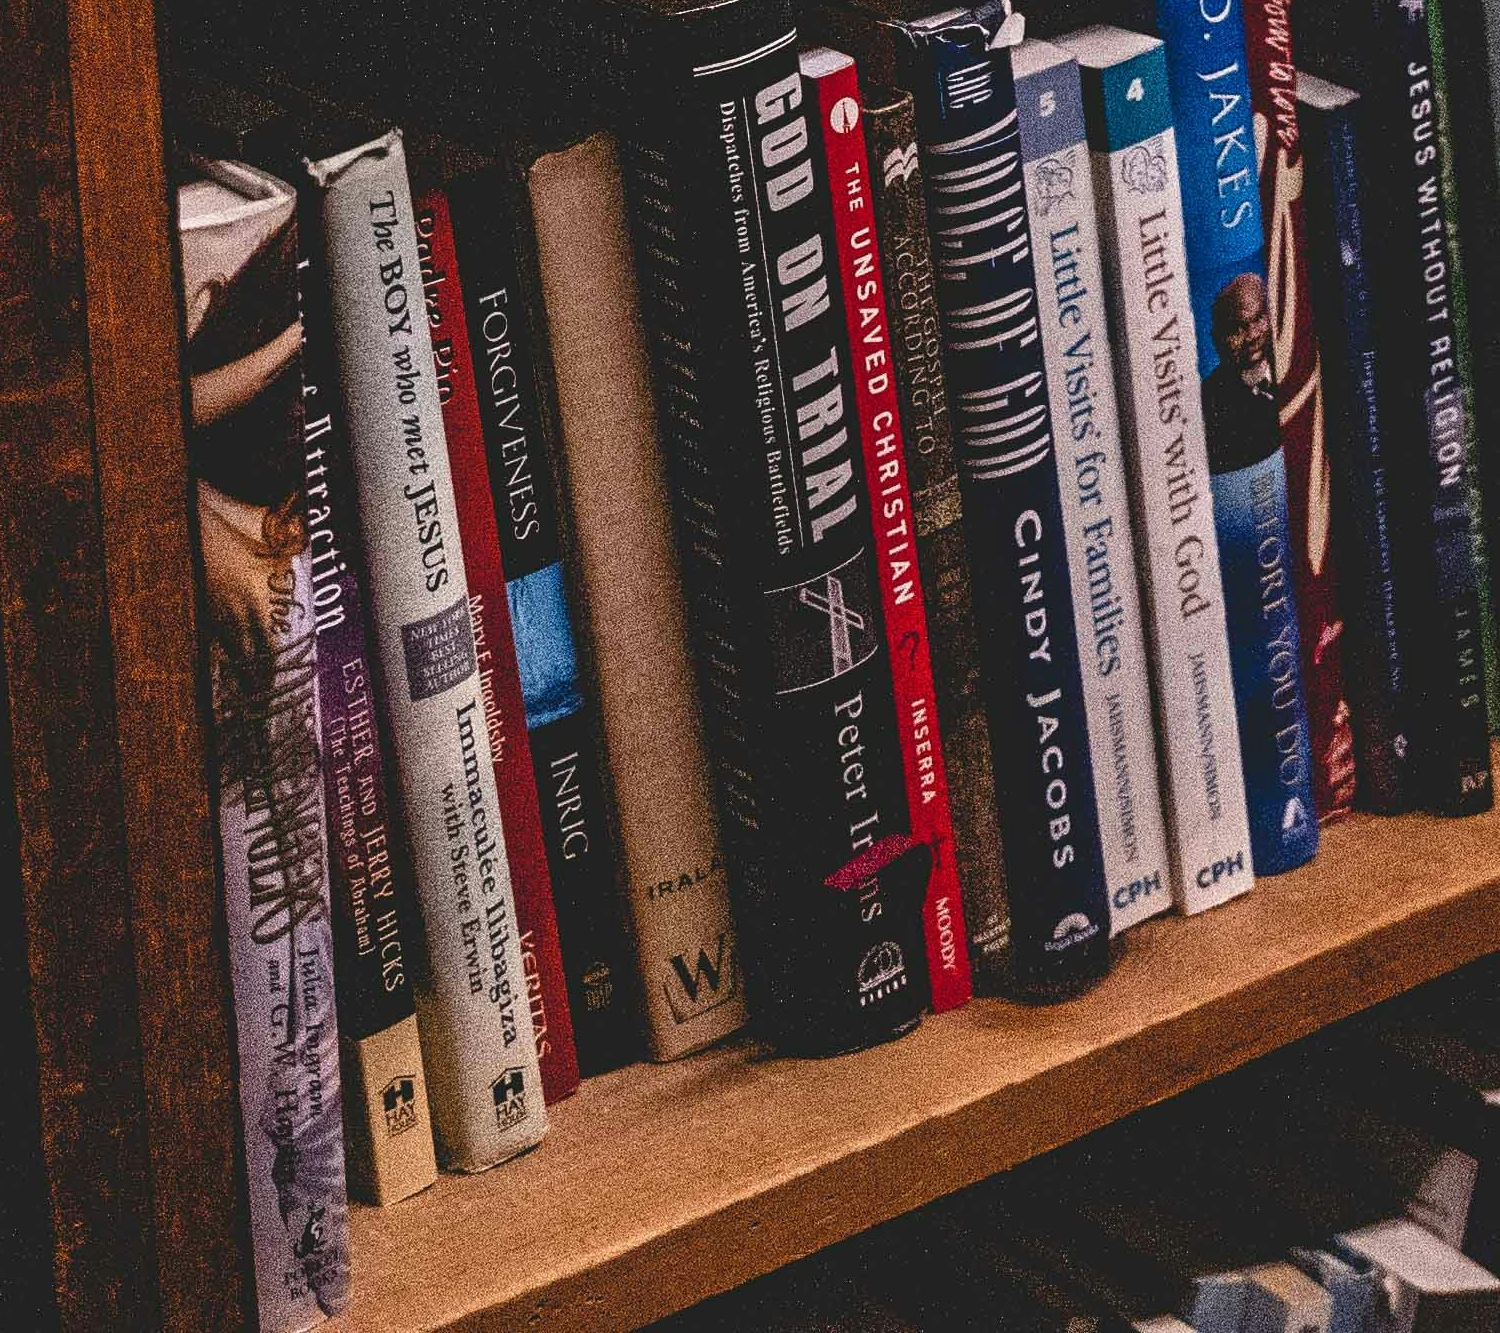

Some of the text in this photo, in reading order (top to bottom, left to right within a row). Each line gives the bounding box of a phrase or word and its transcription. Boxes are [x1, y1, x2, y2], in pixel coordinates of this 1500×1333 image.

[718, 100, 744, 203] Dispatches
[1198, 62, 1252, 230] JAKES
[732, 209, 751, 254] from
[755, 73, 859, 543] GOD ON TRIAL
[1048, 224, 1086, 325] Little
[1407, 62, 1460, 487] JESUS WITHOUT RELIGION
[368, 190, 448, 593] The BOY who met JESUS
[477, 287, 541, 541] FORGIVENESS
[753, 360, 780, 444] Religious
[844, 162, 915, 606] THE UNSAVED CHRISTIAN
[765, 451, 792, 555] Battlefields
[1073, 453, 1105, 509] for
[1081, 515, 1125, 678] Families
[910, 699, 937, 805] INSERRA
[1013, 509, 1076, 870] CINDY JACOBS
[548, 752, 589, 860] INRIG
[833, 691, 889, 923] Peter Irns
